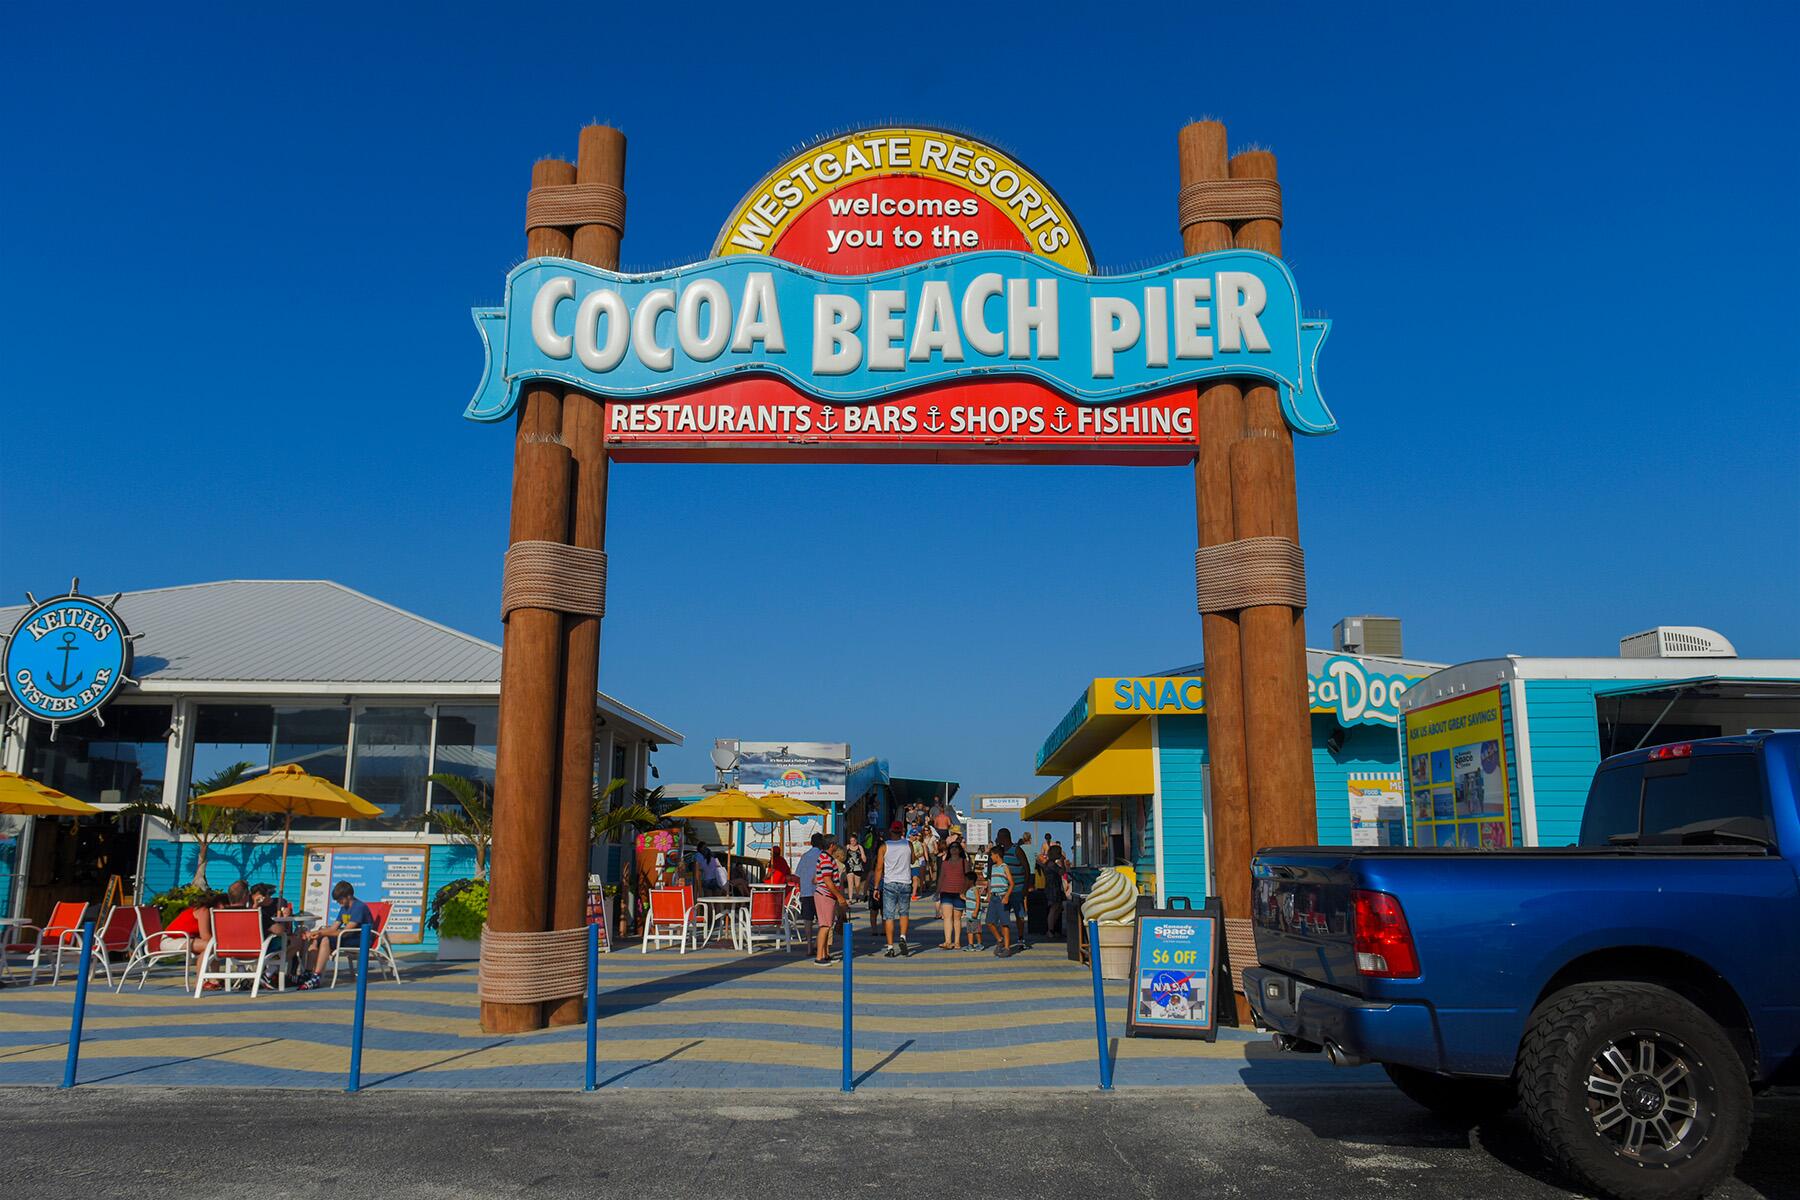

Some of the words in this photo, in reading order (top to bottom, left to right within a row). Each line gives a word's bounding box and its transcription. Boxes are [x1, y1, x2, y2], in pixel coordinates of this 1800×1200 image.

[731, 138, 912, 251] WESTGATE
[921, 140, 1070, 253] RESORTS
[827, 194, 979, 216] welcomes
[827, 229, 884, 252] you
[893, 228, 922, 247] to
[931, 225, 979, 247] the
[531, 271, 787, 373] COCOA
[811, 272, 1059, 376] BEACH
[1090, 271, 1271, 379] PIER
[611, 404, 812, 432] RESTAURANTS
[844, 405, 917, 433] BARS
[950, 405, 1045, 434] SHOPS
[1077, 406, 1192, 434] FISHING
[26, 608, 112, 641] KEITH'S
[17, 669, 78, 711] OYSTER
[79, 668, 111, 705] BAR
[1114, 679, 1206, 710] SNAC
[1428, 721, 1447, 736] ABOUT
[1448, 716, 1467, 730] GREAT
[1454, 755, 1474, 764] Space
[1154, 926, 1195, 936] Space
[1153, 949, 1169, 965] $6
[1174, 950, 1197, 964] OFF
[1153, 982, 1188, 992] NASA
